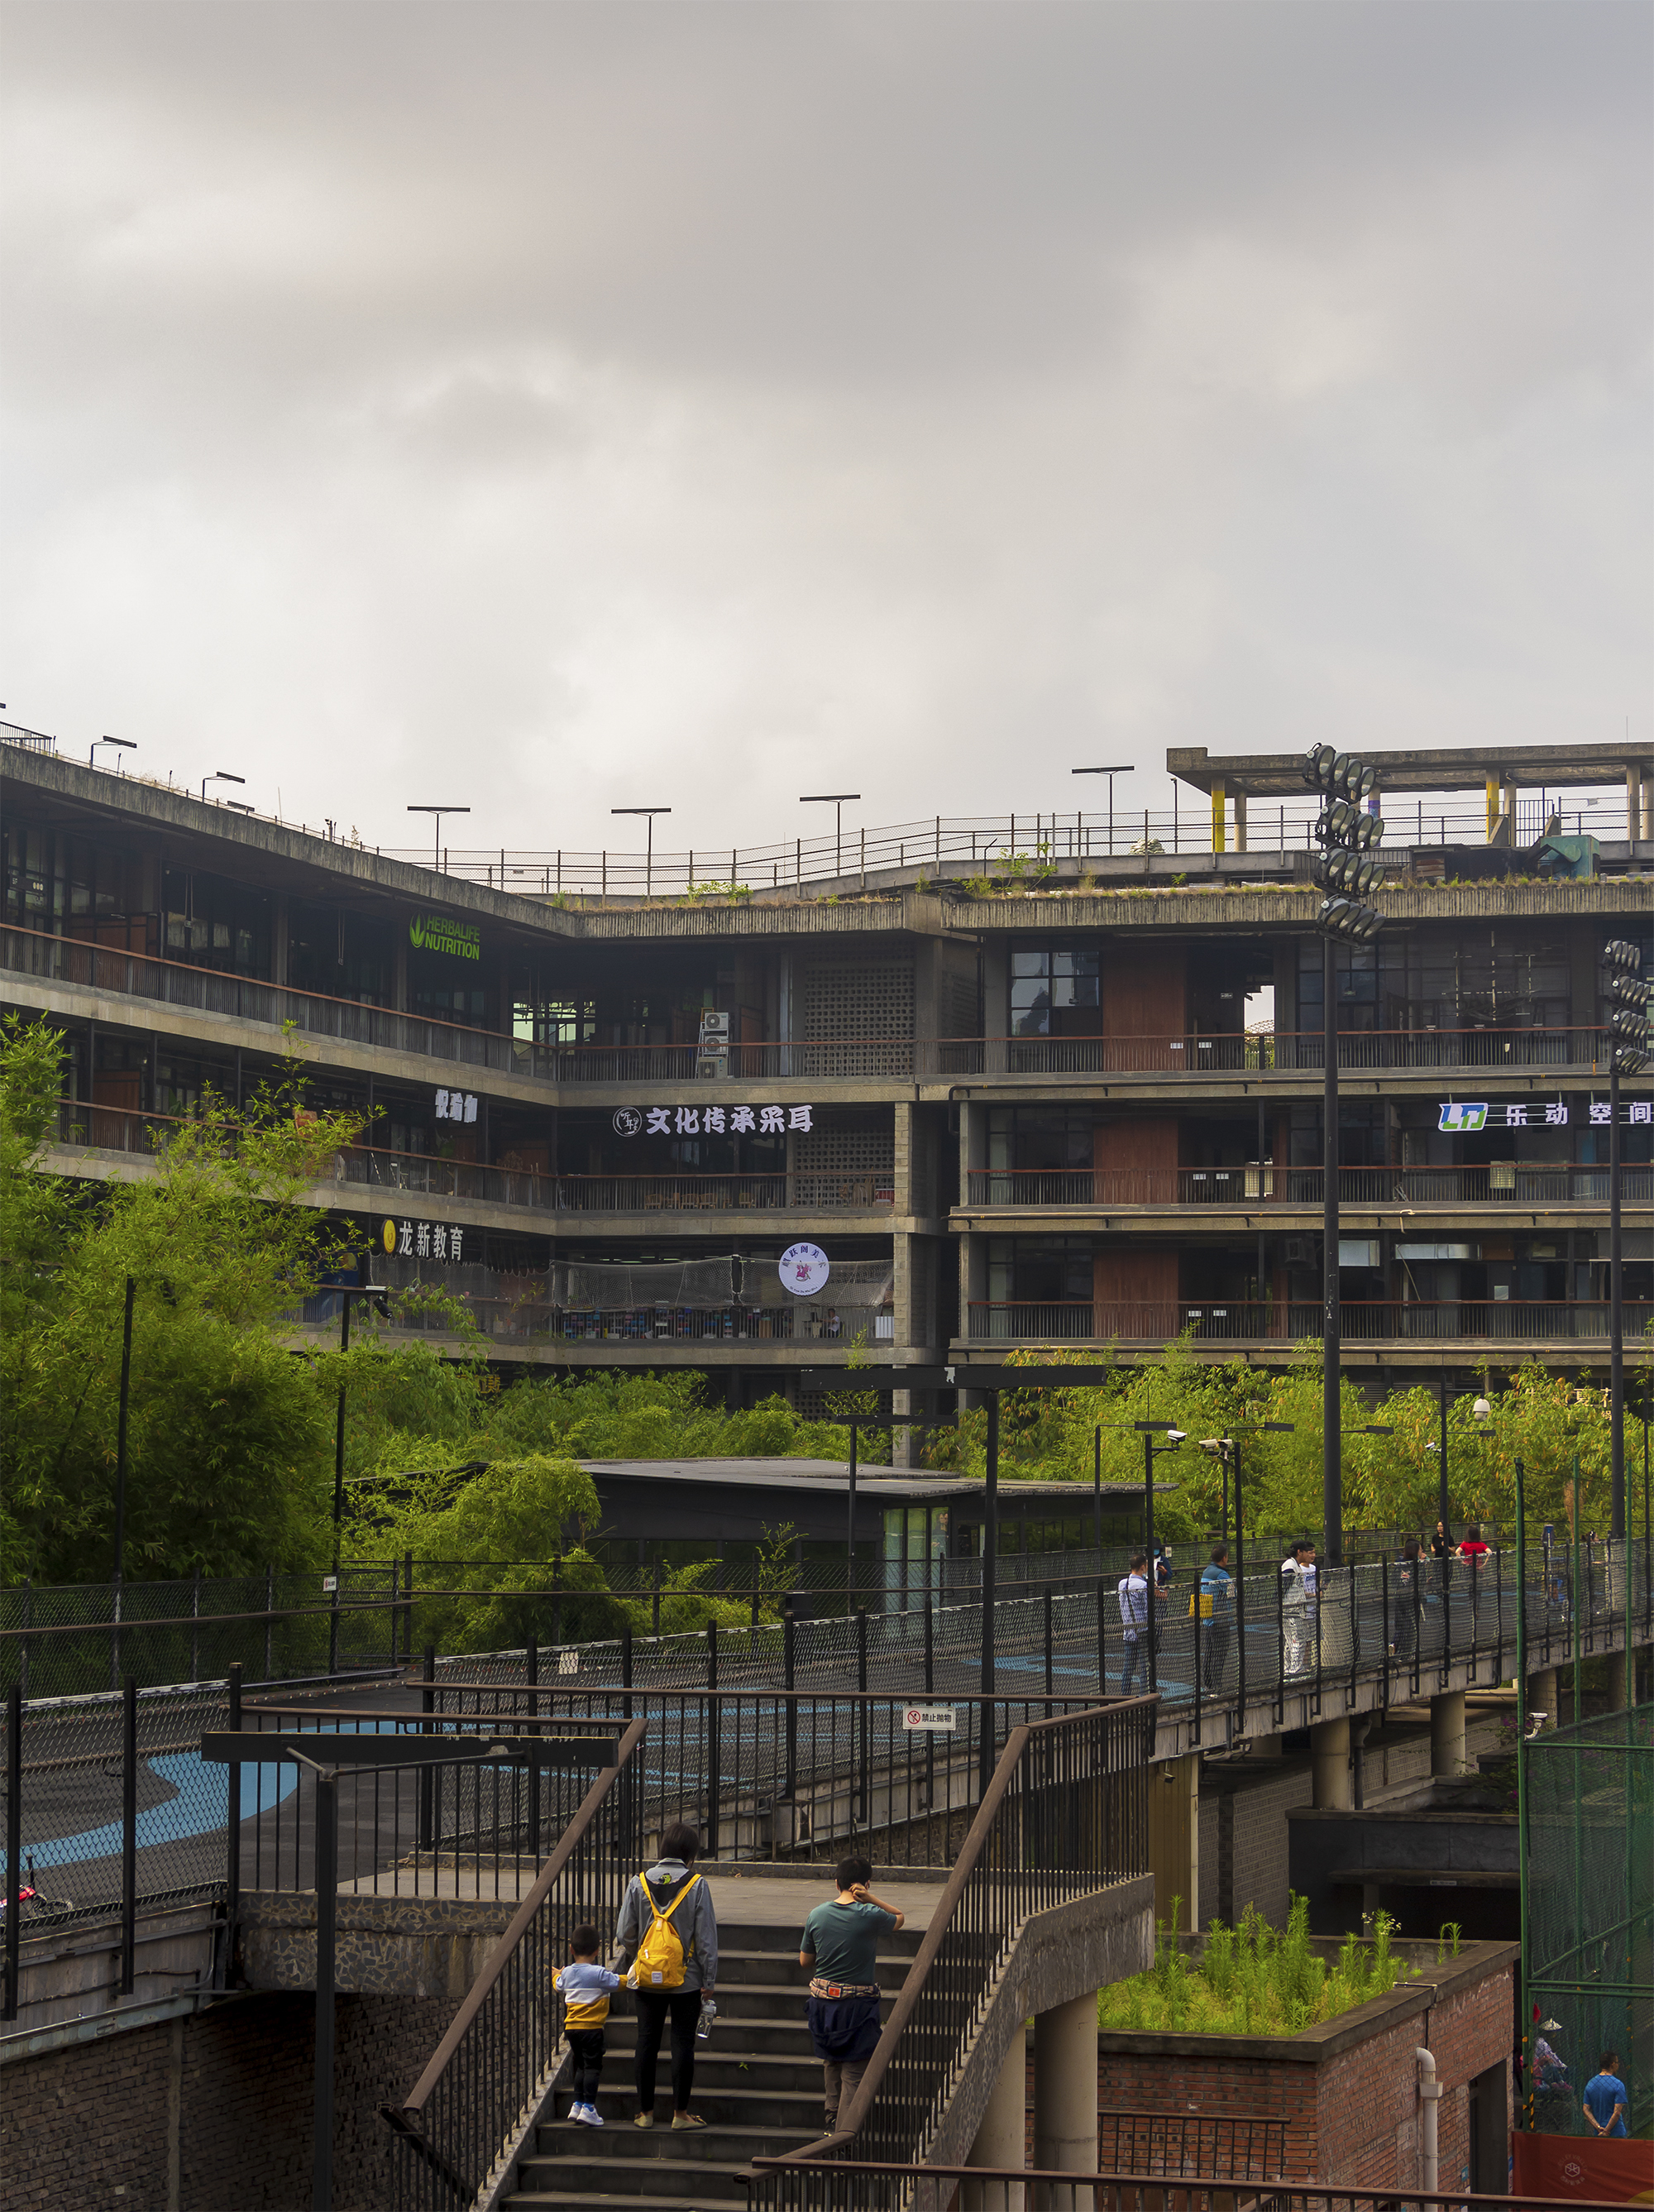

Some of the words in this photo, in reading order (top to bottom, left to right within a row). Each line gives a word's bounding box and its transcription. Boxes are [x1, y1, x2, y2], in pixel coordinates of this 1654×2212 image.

[427, 915, 480, 942] HERBALIFE
[425, 932, 480, 960] NUTRITION
[1507, 1102, 1652, 1127] 乐动空间
[399, 1221, 463, 1261] 龙新教育
[921, 1713, 952, 1723] 禁止抛物
